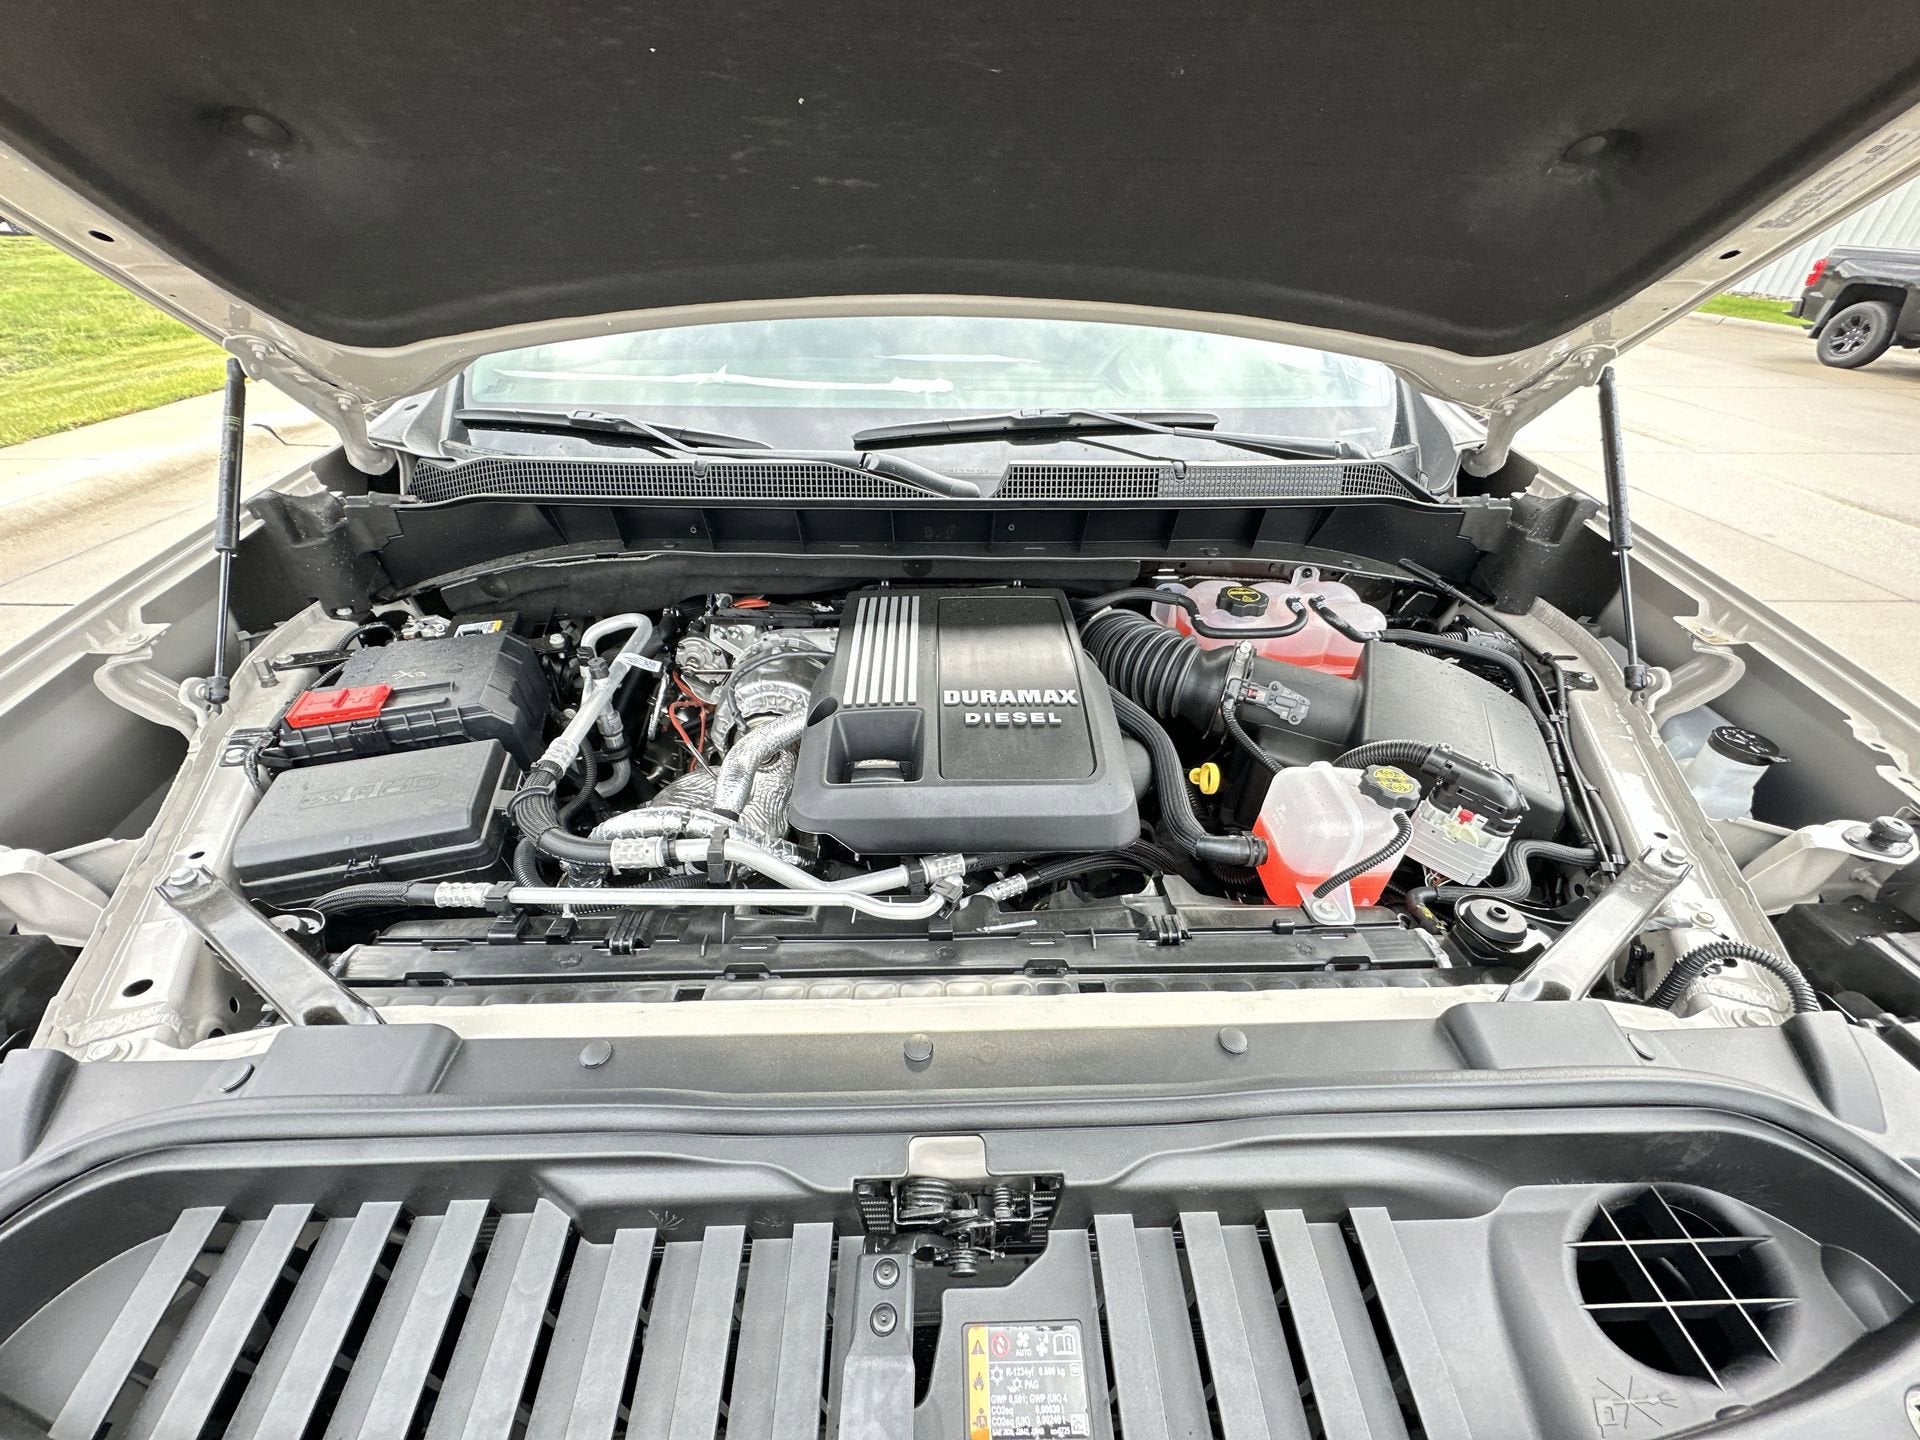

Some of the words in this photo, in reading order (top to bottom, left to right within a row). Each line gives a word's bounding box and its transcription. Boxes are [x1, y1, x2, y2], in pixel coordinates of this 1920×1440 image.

[943, 689, 1078, 706] DURAMAX
[965, 712, 1062, 726] DIESEL
[1015, 1348, 1032, 1357] AUTO
[1024, 1379, 1039, 1390] PAG
[991, 1395, 1007, 1404] GWP
[1029, 1393, 1046, 1404] GWP
